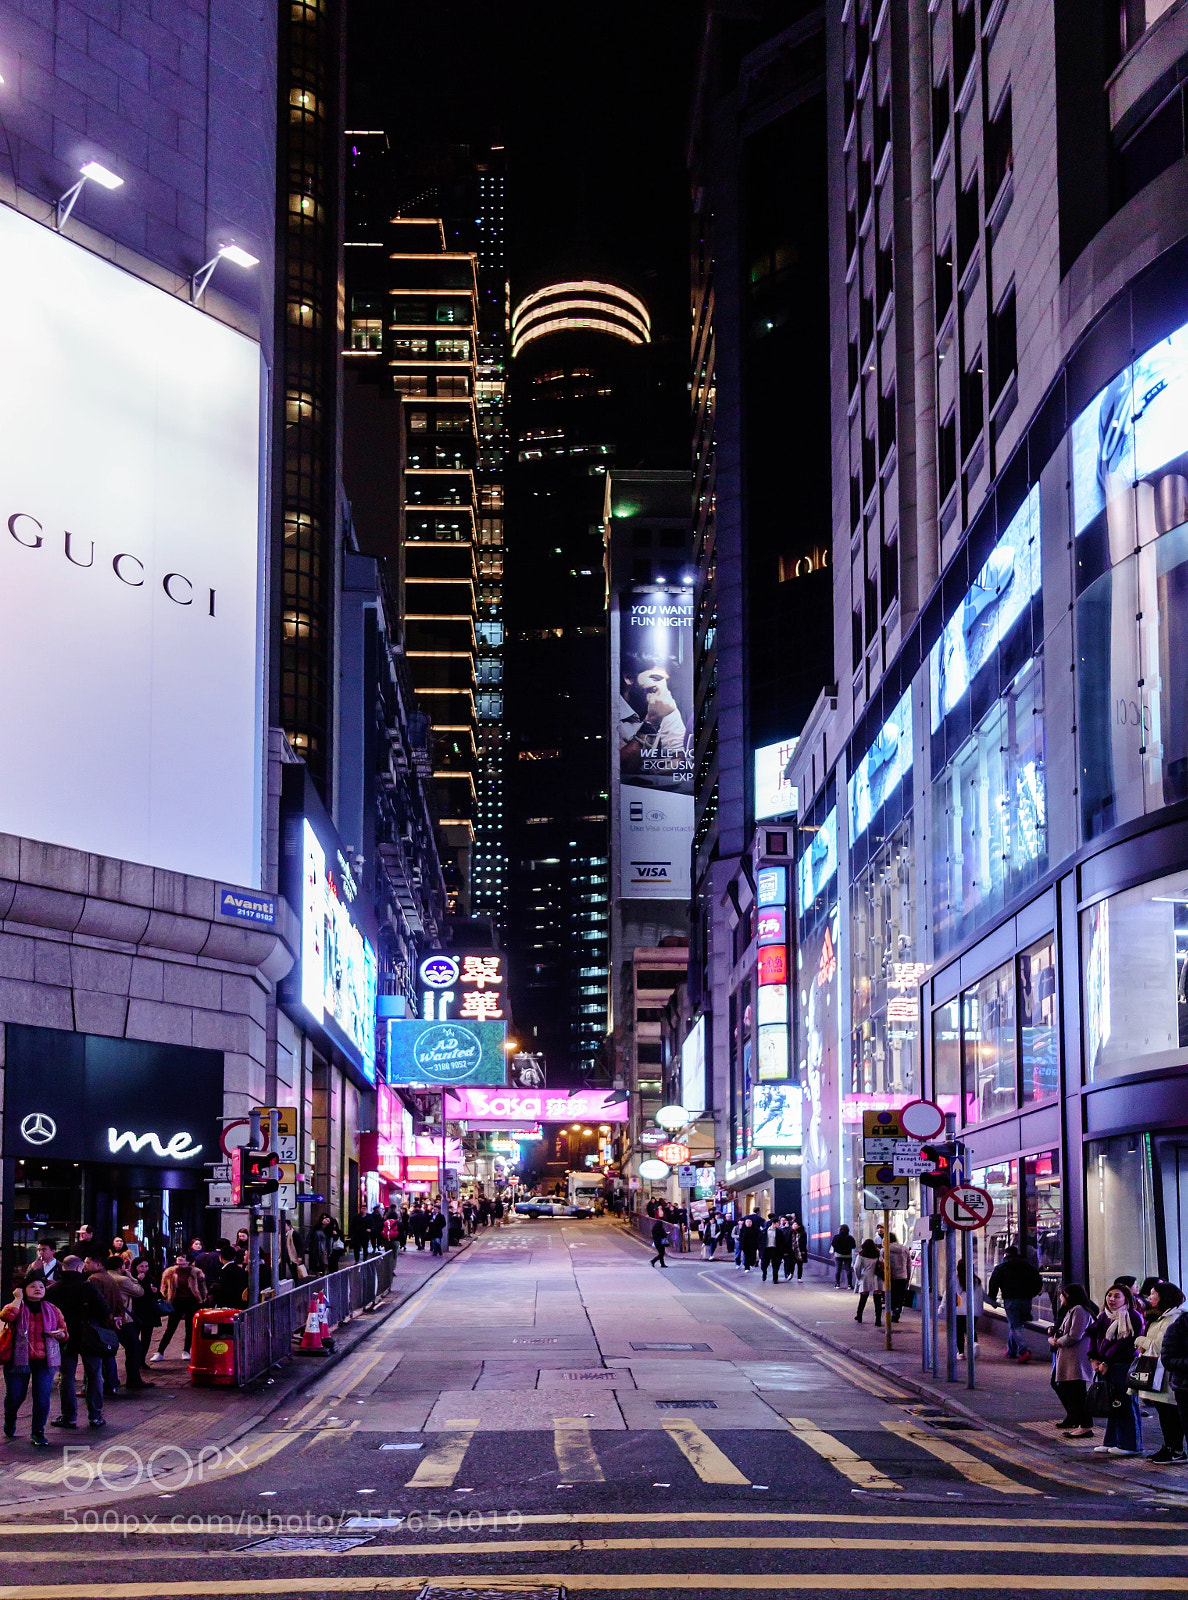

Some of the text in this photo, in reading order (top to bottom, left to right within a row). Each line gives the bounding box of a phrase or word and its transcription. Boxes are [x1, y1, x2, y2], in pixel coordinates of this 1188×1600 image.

[7, 512, 217, 617] GUCCI
[631, 605, 694, 614] YOU WANT
[631, 617, 694, 627] FUN NIGHT
[640, 749, 658, 758] WE
[660, 749, 681, 758] LET
[636, 867, 668, 877] VISA
[223, 895, 274, 914] Avanti
[237, 908, 255, 917] 2117
[460, 956, 503, 1021] 翠華
[432, 1038, 458, 1051] AD
[420, 1046, 476, 1062] Wanted
[107, 1127, 204, 1159] me
[280, 1137, 288, 1145] 7
[280, 1151, 293, 1159] 12
[280, 1186, 288, 1194] 7
[892, 1187, 900, 1196] 7
[280, 1199, 288, 1207] 7
[892, 1200, 900, 1208] 7
